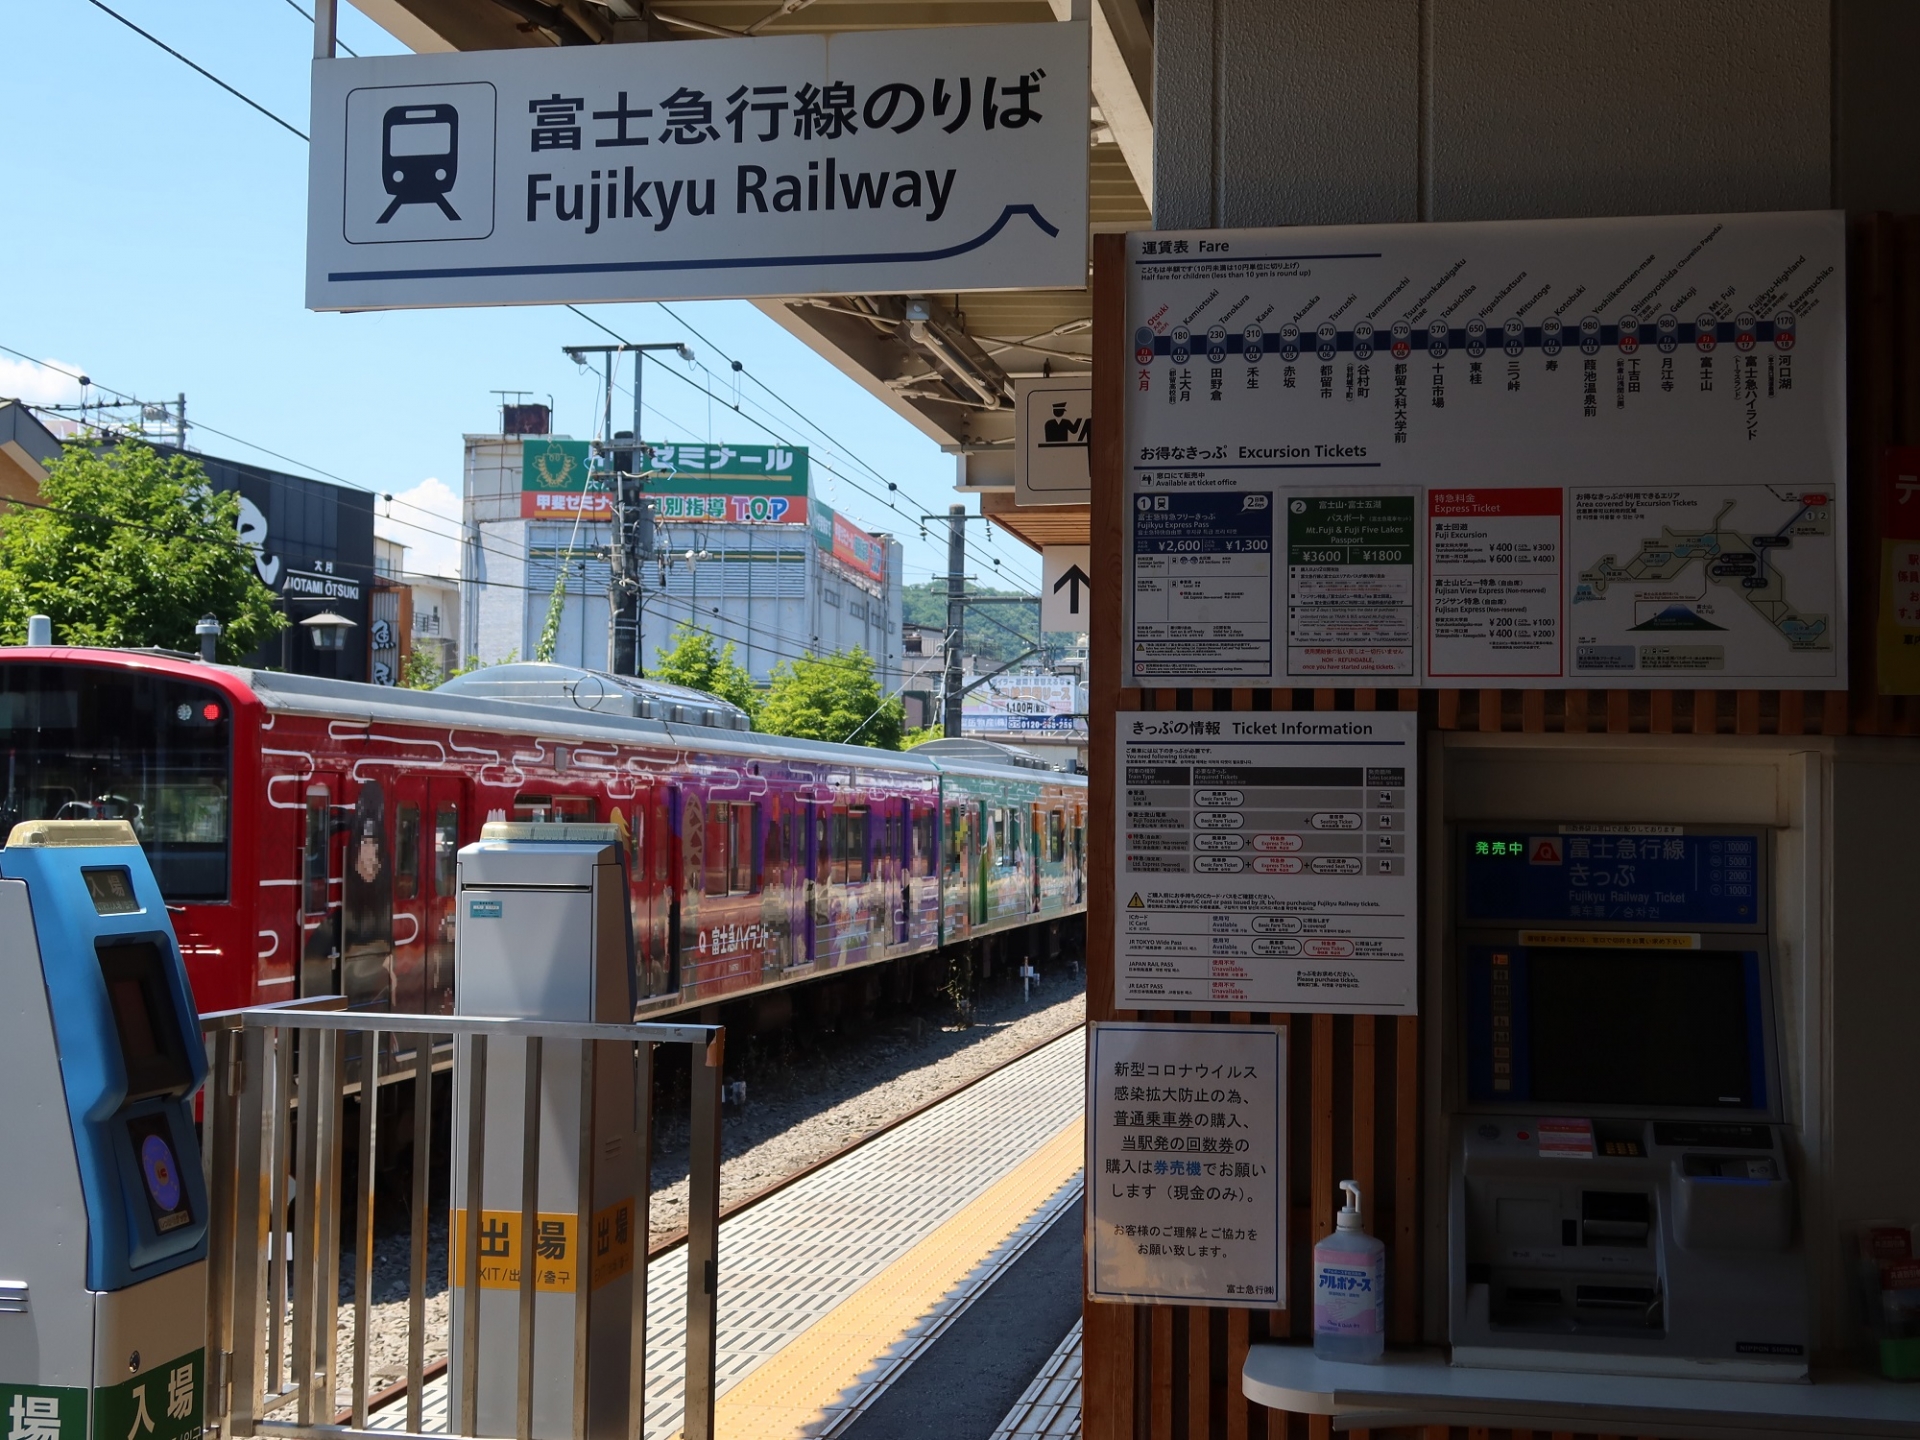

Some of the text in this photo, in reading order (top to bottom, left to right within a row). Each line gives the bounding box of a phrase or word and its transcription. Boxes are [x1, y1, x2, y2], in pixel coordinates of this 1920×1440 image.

[528, 68, 1046, 152] 富士急行線のりば
[527, 157, 956, 233] Fujikyu Railway
[1142, 240, 1229, 255] 運賃表 Fare
[1630, 268, 1679, 314] Shimoyoshida
[1700, 223, 1723, 247] Pagoda)
[1402, 258, 1467, 320] Tsurubunkadaigaku
[1591, 253, 1656, 315] Yoshiikeonsen-mae
[1748, 255, 1806, 312] Fujikyu-Highland
[1787, 265, 1834, 311] Kawaguchiko
[1365, 276, 1411, 321] Yamuramachi
[1440, 284, 1477, 319] Tokaichiba
[1478, 271, 1527, 319] Higashikatsura
[1515, 283, 1552, 318] Mitsutoge
[1554, 285, 1587, 317] Kotobuki
[1669, 286, 1698, 313] Gekkoji
[1708, 285, 1737, 312] Mt. Fuji
[1147, 303, 1169, 326] Otsuki
[1183, 289, 1219, 326] Kamiotsuki
[1218, 293, 1250, 325] Tanokura
[1255, 304, 1275, 324] Kasei
[1292, 294, 1321, 323] Akasaka
[1328, 293, 1358, 322] Tsurushi
[1410, 307, 1428, 326] -mae
[1621, 320, 1636, 330] 980
[1659, 319, 1675, 329] 980
[1698, 318, 1715, 328] 1040
[1737, 317, 1754, 326] 1100
[1776, 316, 1794, 326] 1170
[1246, 330, 1260, 338] 310
[1283, 329, 1297, 337] 390
[1319, 328, 1334, 337] 470
[1356, 327, 1371, 336] 470
[1393, 326, 1409, 335] 570
[1431, 325, 1446, 334] 570
[1468, 324, 1484, 333] 650
[1506, 323, 1522, 332] 730
[1544, 322, 1560, 331] 890
[1582, 321, 1598, 330] 980
[1174, 332, 1188, 341] 180
[1209, 331, 1224, 339] 230
[1469, 362, 1483, 385] 東桂
[1545, 360, 1558, 371] 寿
[1700, 356, 1713, 391] 富士山
[1778, 355, 1792, 390] 河口湖
[1138, 369, 1150, 391] 大月
[1246, 367, 1259, 389] 禾生
[1283, 365, 1296, 388] 赤坂
[1320, 364, 1333, 399] 都留市
[1357, 363, 1370, 398] 谷村町
[1507, 361, 1521, 392] 三つ峠
[1628, 358, 1641, 393] 下吉田
[1661, 358, 1674, 392] 月江寺
[1179, 368, 1192, 402] 上大月
[1210, 368, 1223, 401] 田野倉
[1431, 362, 1445, 409] 十日市場
[1394, 363, 1407, 444] 都留文科大学前
[1745, 355, 1758, 440] 富士急ハイランド
[588, 448, 794, 472] ゼミナール
[1140, 444, 1367, 460] お得なきっぷ Excursion Tickets
[1197, 479, 1216, 487] ticket
[1218, 478, 1237, 486] office
[536, 495, 613, 511] 甲斐ゼミナ
[1435, 494, 1475, 503] 特急料金
[1622, 500, 1635, 509] by
[1636, 500, 1671, 508] Excursion
[1672, 499, 1698, 507] Tickets
[1327, 513, 1366, 522] パスポート
[1435, 504, 1501, 514] Express Ticket
[1137, 521, 1163, 530] Fujikyu
[1165, 521, 1192, 530] Express
[1306, 526, 1334, 535] Mt.Fuji
[1344, 526, 1360, 535] Fuji
[1381, 525, 1404, 533] Lakes
[1435, 523, 1468, 531] 富士回遊
[1331, 536, 1364, 545] Passport
[1435, 531, 1487, 539] Fuji Excursion
[1159, 540, 1201, 552] ¥2,600
[1226, 539, 1268, 551] ¥1,300
[1489, 543, 1513, 552] ¥400
[1303, 551, 1341, 562] ¥3600
[1363, 550, 1402, 561] ¥1800
[1489, 554, 1513, 563] ¥600
[315, 560, 334, 573] 大月
[325, 580, 359, 599] ŌTSUKI
[1435, 587, 1459, 595] Fujisan
[1478, 587, 1504, 595] Express
[1489, 618, 1513, 627] ¥200
[1489, 629, 1513, 638] ¥400
[1132, 721, 1373, 736] きっぷの情報 Ticket Information
[1475, 841, 1523, 856] 発売中
[1569, 838, 1685, 860] 富士急行線
[1727, 842, 1749, 852] 10000
[1728, 857, 1747, 866] 5000
[1569, 864, 1636, 887] きっぷ
[1728, 871, 1747, 881] 2000
[87, 875, 125, 898] 入場
[1728, 885, 1747, 895] 1000
[1568, 890, 1685, 904] Fujikyu Railway Ticket
[1114, 1061, 1258, 1079] 新型コロナウイルス
[1114, 1086, 1250, 1104] 感染拡大防止の為、
[1113, 1111, 1250, 1129] 普通乗車券の購入、
[1122, 1136, 1250, 1153] 当駅発の回数券の
[1106, 1159, 1267, 1177] 購入は券売機でお願い
[1112, 1183, 1253, 1203] します（現金のみ）。
[481, 1219, 566, 1260] 出場
[597, 1207, 628, 1257] 出場
[1114, 1224, 1258, 1241] お客様のご理解とご協力を
[1137, 1243, 1228, 1259] お願い致します。
[1319, 1274, 1372, 1292] アルボナース
[1739, 1345, 1799, 1354] NIPPON SIGNAL
[127, 1363, 194, 1440] 入場
